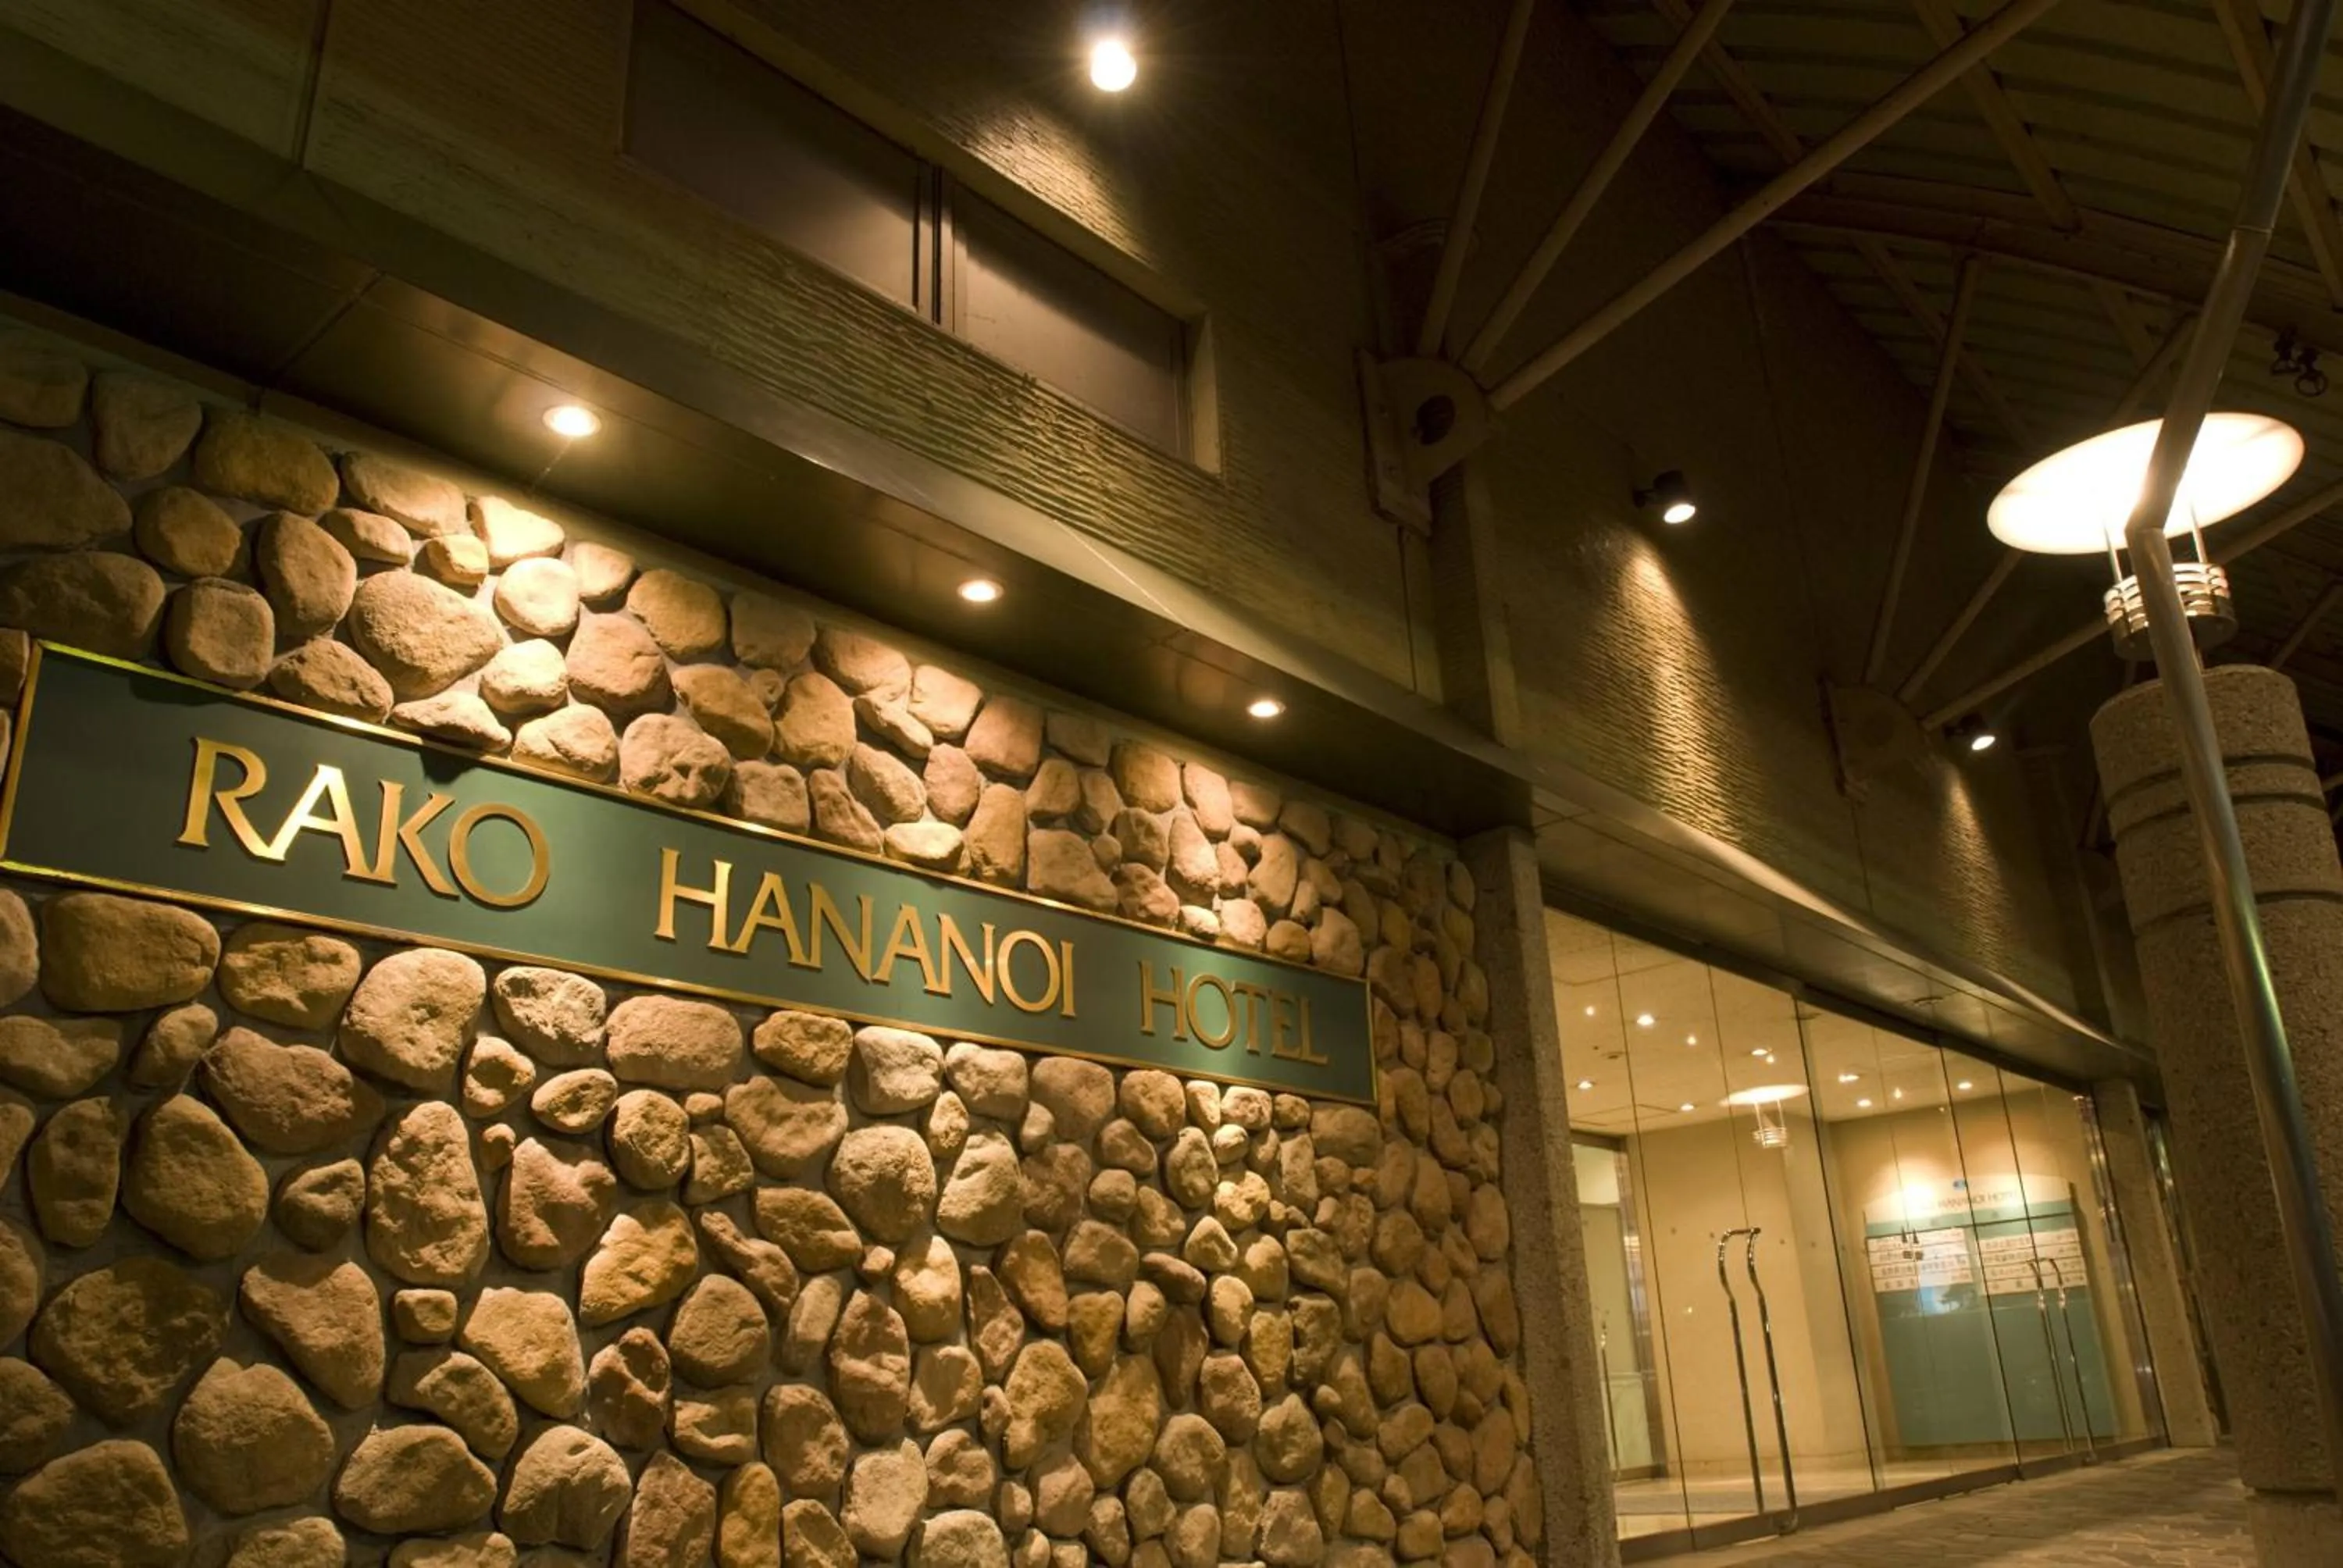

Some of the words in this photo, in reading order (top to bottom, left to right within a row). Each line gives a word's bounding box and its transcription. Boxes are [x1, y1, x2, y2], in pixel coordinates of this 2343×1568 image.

[177, 736, 550, 907] RAKO
[654, 846, 1075, 1017] HANANOI
[1139, 960, 1328, 1065] HOTEL
